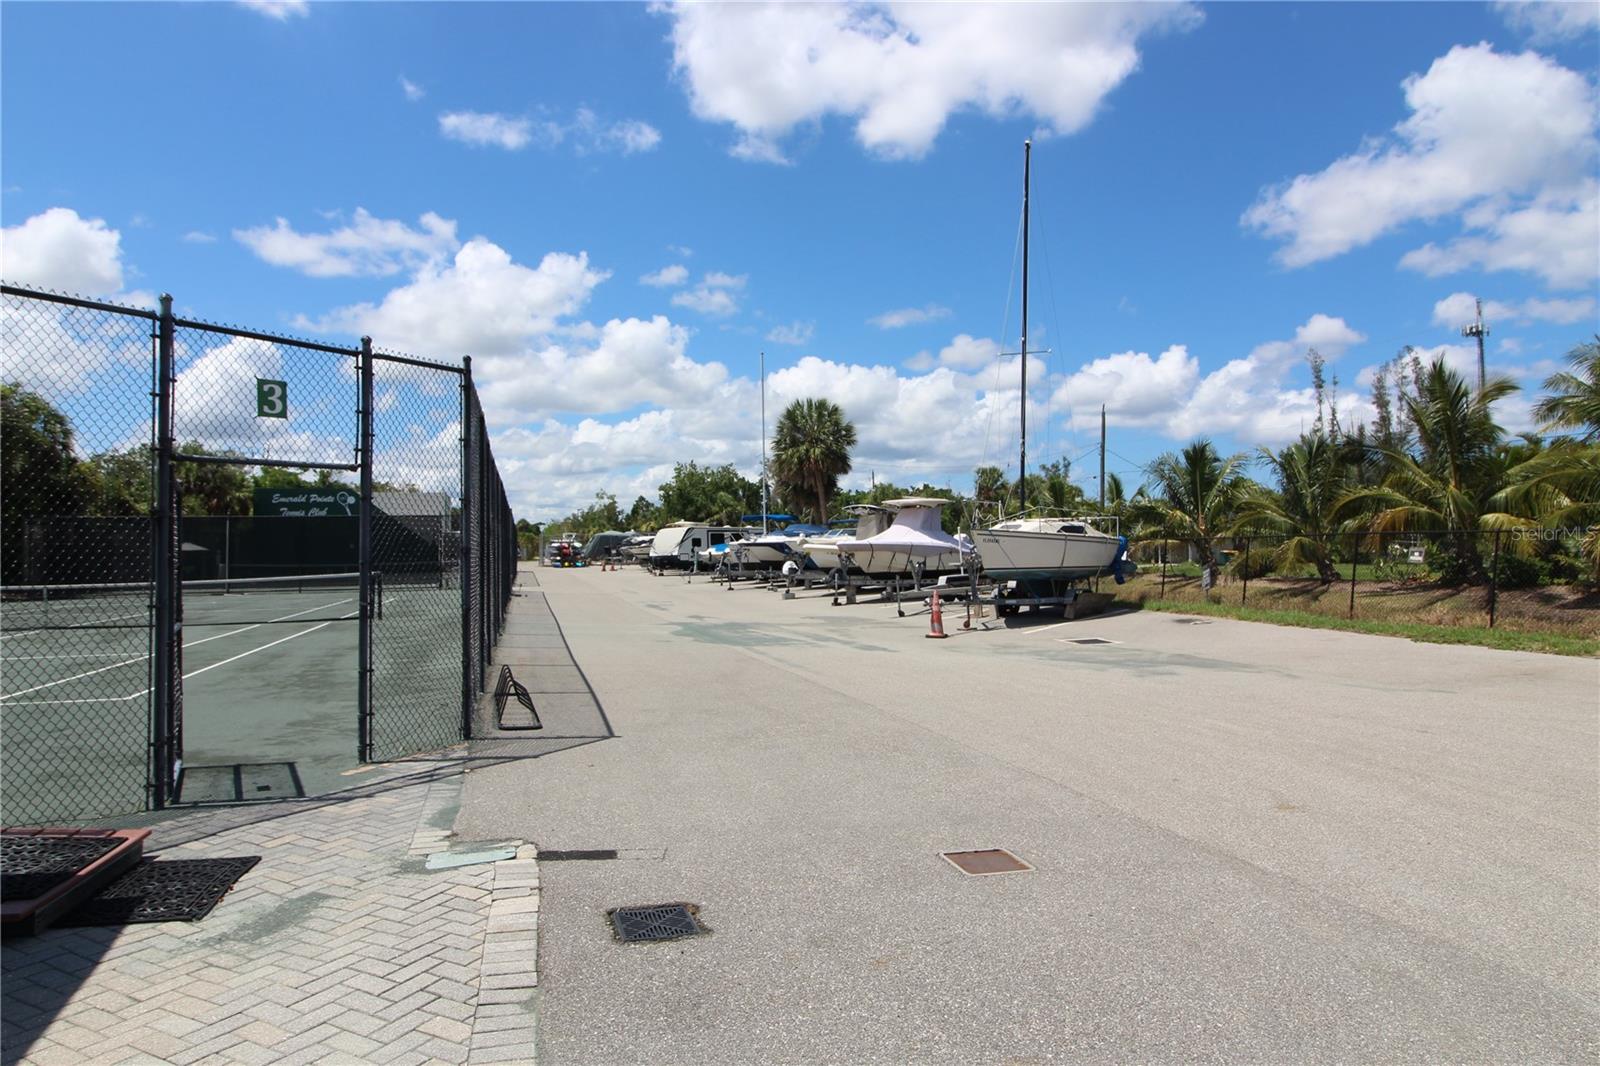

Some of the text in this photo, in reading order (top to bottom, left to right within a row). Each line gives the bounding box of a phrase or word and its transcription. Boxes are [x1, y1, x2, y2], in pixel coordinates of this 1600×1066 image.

[263, 383, 283, 414] 3
[271, 493, 308, 504] Emerald
[279, 507, 329, 517] Tennis Club
